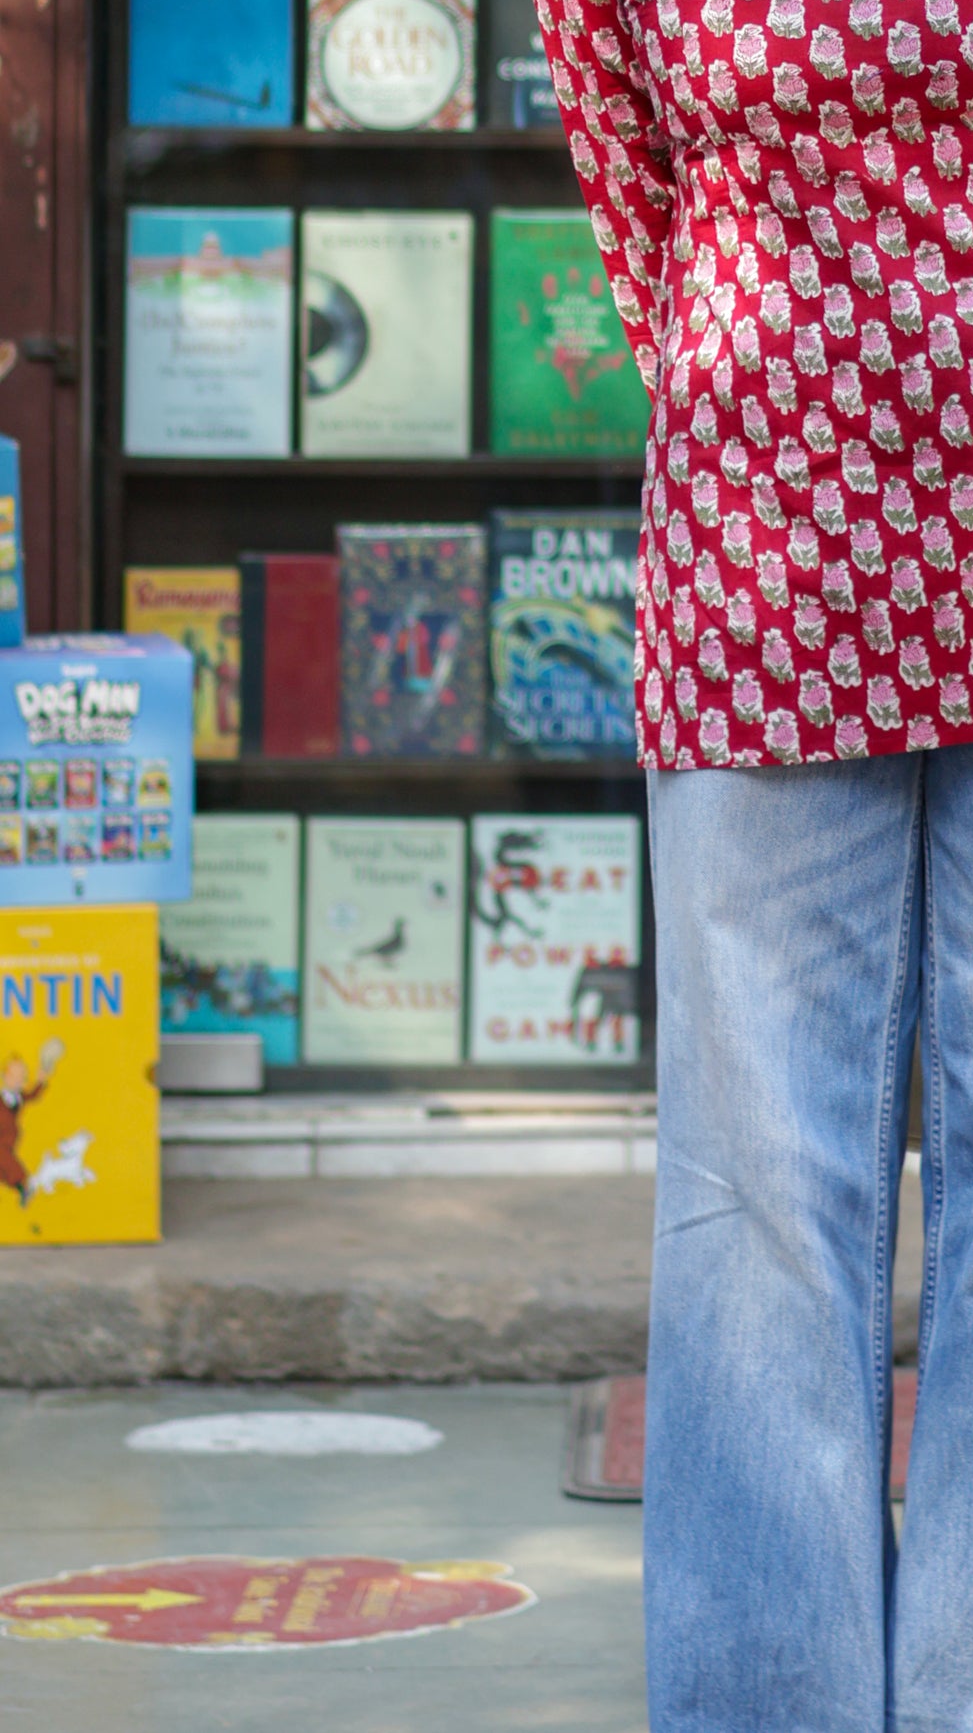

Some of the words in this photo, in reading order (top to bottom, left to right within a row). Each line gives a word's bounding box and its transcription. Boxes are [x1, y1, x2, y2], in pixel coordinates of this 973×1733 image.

[332, 24, 448, 52] GOLDEN
[347, 51, 433, 79] ROAD
[532, 528, 613, 558] DAN
[502, 557, 637, 599] BROWN
[15, 680, 78, 721] DOG
[3, 972, 123, 1018] NTIN
[313, 960, 460, 1011] Nexus
